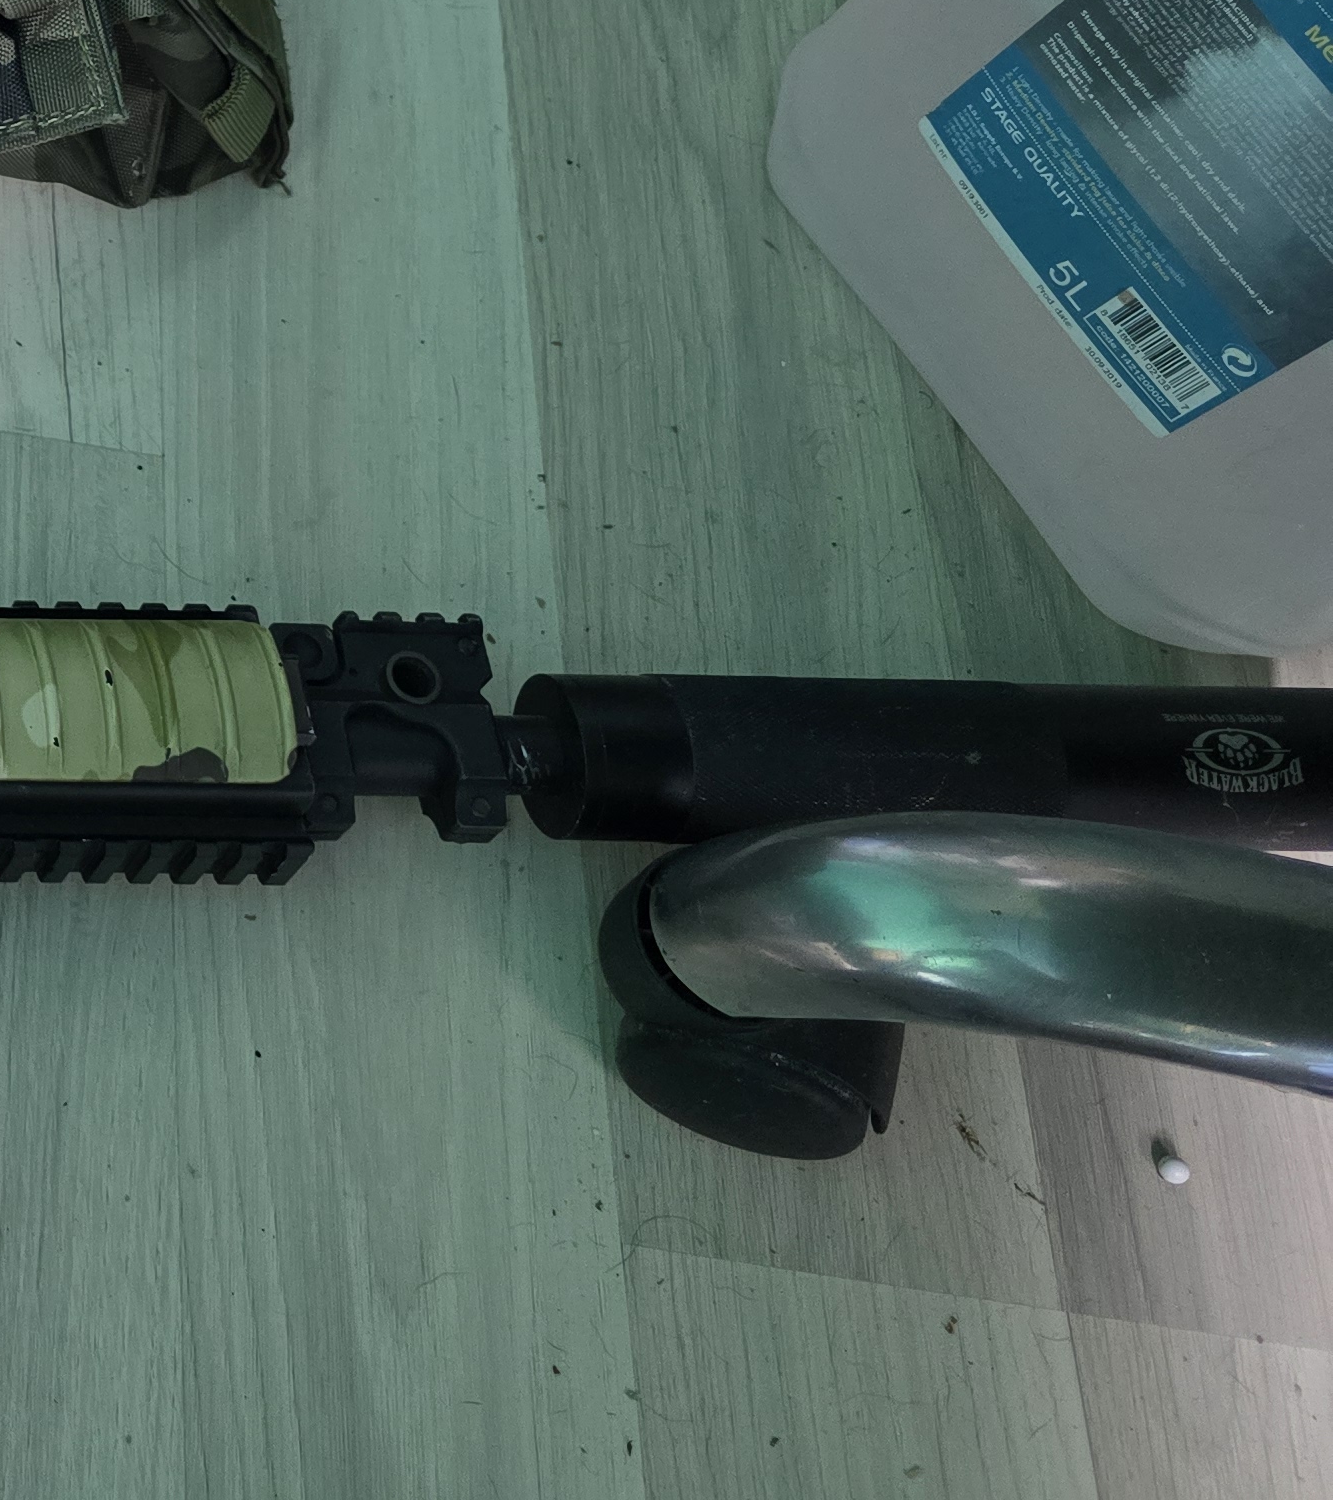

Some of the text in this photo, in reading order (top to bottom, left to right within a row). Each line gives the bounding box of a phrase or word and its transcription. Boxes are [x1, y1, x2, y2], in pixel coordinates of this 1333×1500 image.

[1077, 8, 1108, 43] Storage
[1044, 35, 1062, 54] The
[1050, 30, 1096, 85] Composition:
[1101, 39, 1122, 61] only
[1055, 51, 1086, 86] product
[1117, 57, 1130, 70] in
[1064, 77, 1088, 105] water.
[1080, 82, 1092, 94] is
[1086, 90, 1096, 100] a
[1123, 66, 1154, 102] original
[1064, 19, 1242, 236] Disposal: In accordance with the local and national laws.
[1091, 96, 1121, 132] mixture
[1149, 97, 1187, 142] container,
[927, 132, 942, 149] Lot
[1116, 127, 1130, 141] of
[1182, 137, 1203, 161] cool,
[977, 86, 1085, 223] STAGE QUALITY
[1028, 91, 1056, 123] Density
[1070, 145, 1085, 160] for
[1079, 157, 1107, 189] making
[1117, 204, 1134, 222] and
[1122, 138, 1149, 167] glycol
[1198, 158, 1216, 177] dry
[1010, 78, 1039, 112] Medium
[1032, 110, 1062, 144] Density
[1060, 145, 1092, 183] standard
[1114, 214, 1129, 230] for
[1150, 258, 1172, 283] disco
[1017, 105, 1046, 137] Density
[1083, 189, 1110, 220] intense
[1105, 217, 1130, 245] smoke
[1124, 240, 1150, 270] effects
[1211, 173, 1230, 193] and
[1044, 254, 1099, 314] 5L
[1254, 294, 1275, 317] and
[1083, 344, 1123, 390] 30.09.2019
[1094, 322, 1171, 412] code: 1421200007
[1098, 307, 1109, 318] 8
[1143, 359, 1173, 394] 02138
[1179, 401, 1191, 413] 7
[1181, 755, 1304, 793] BLACKWATER
